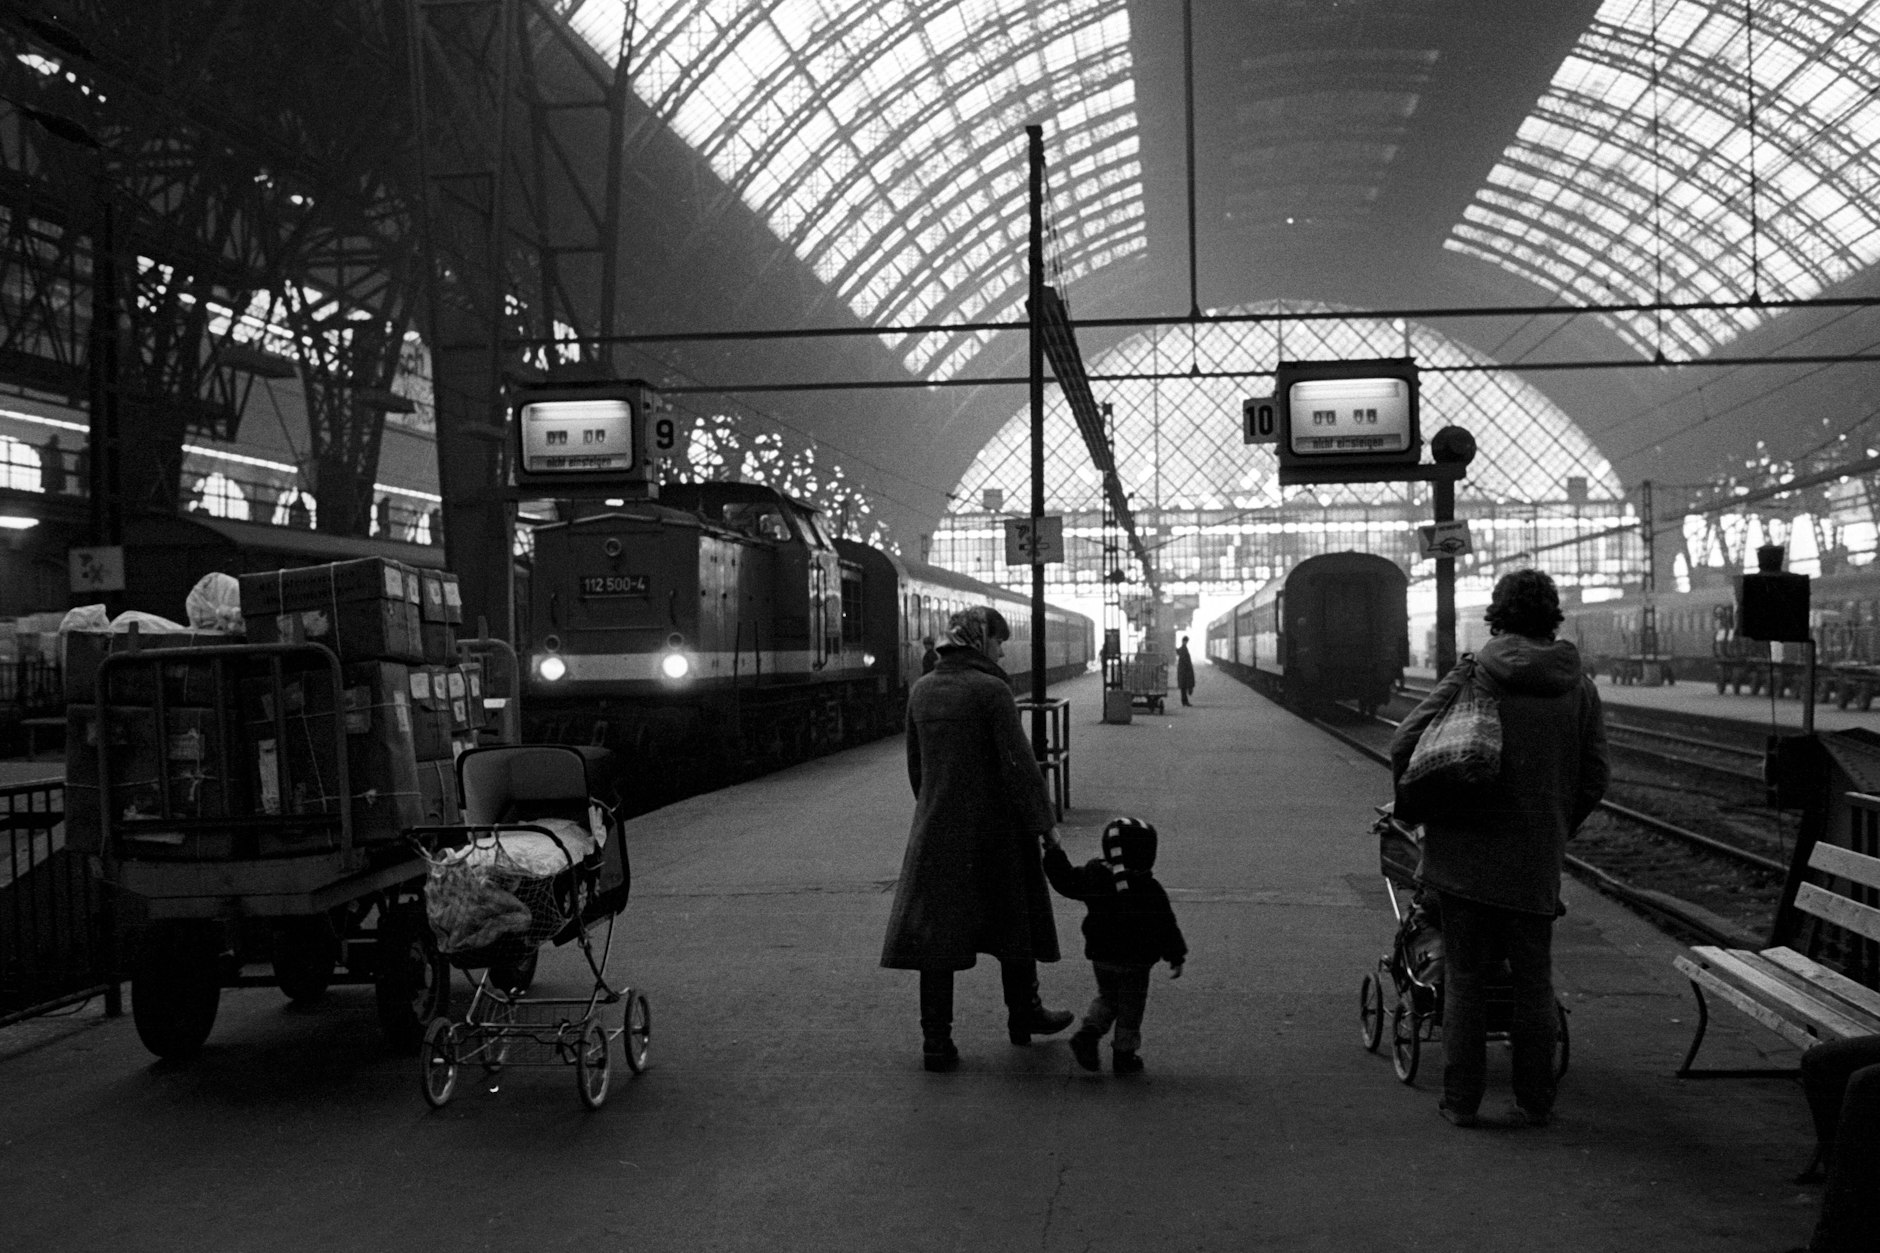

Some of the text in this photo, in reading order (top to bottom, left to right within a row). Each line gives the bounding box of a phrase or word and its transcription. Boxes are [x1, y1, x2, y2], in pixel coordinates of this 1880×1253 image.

[656, 419, 674, 449] 9
[1246, 406, 1273, 436] 10
[585, 577, 645, 592] 112 500-4
